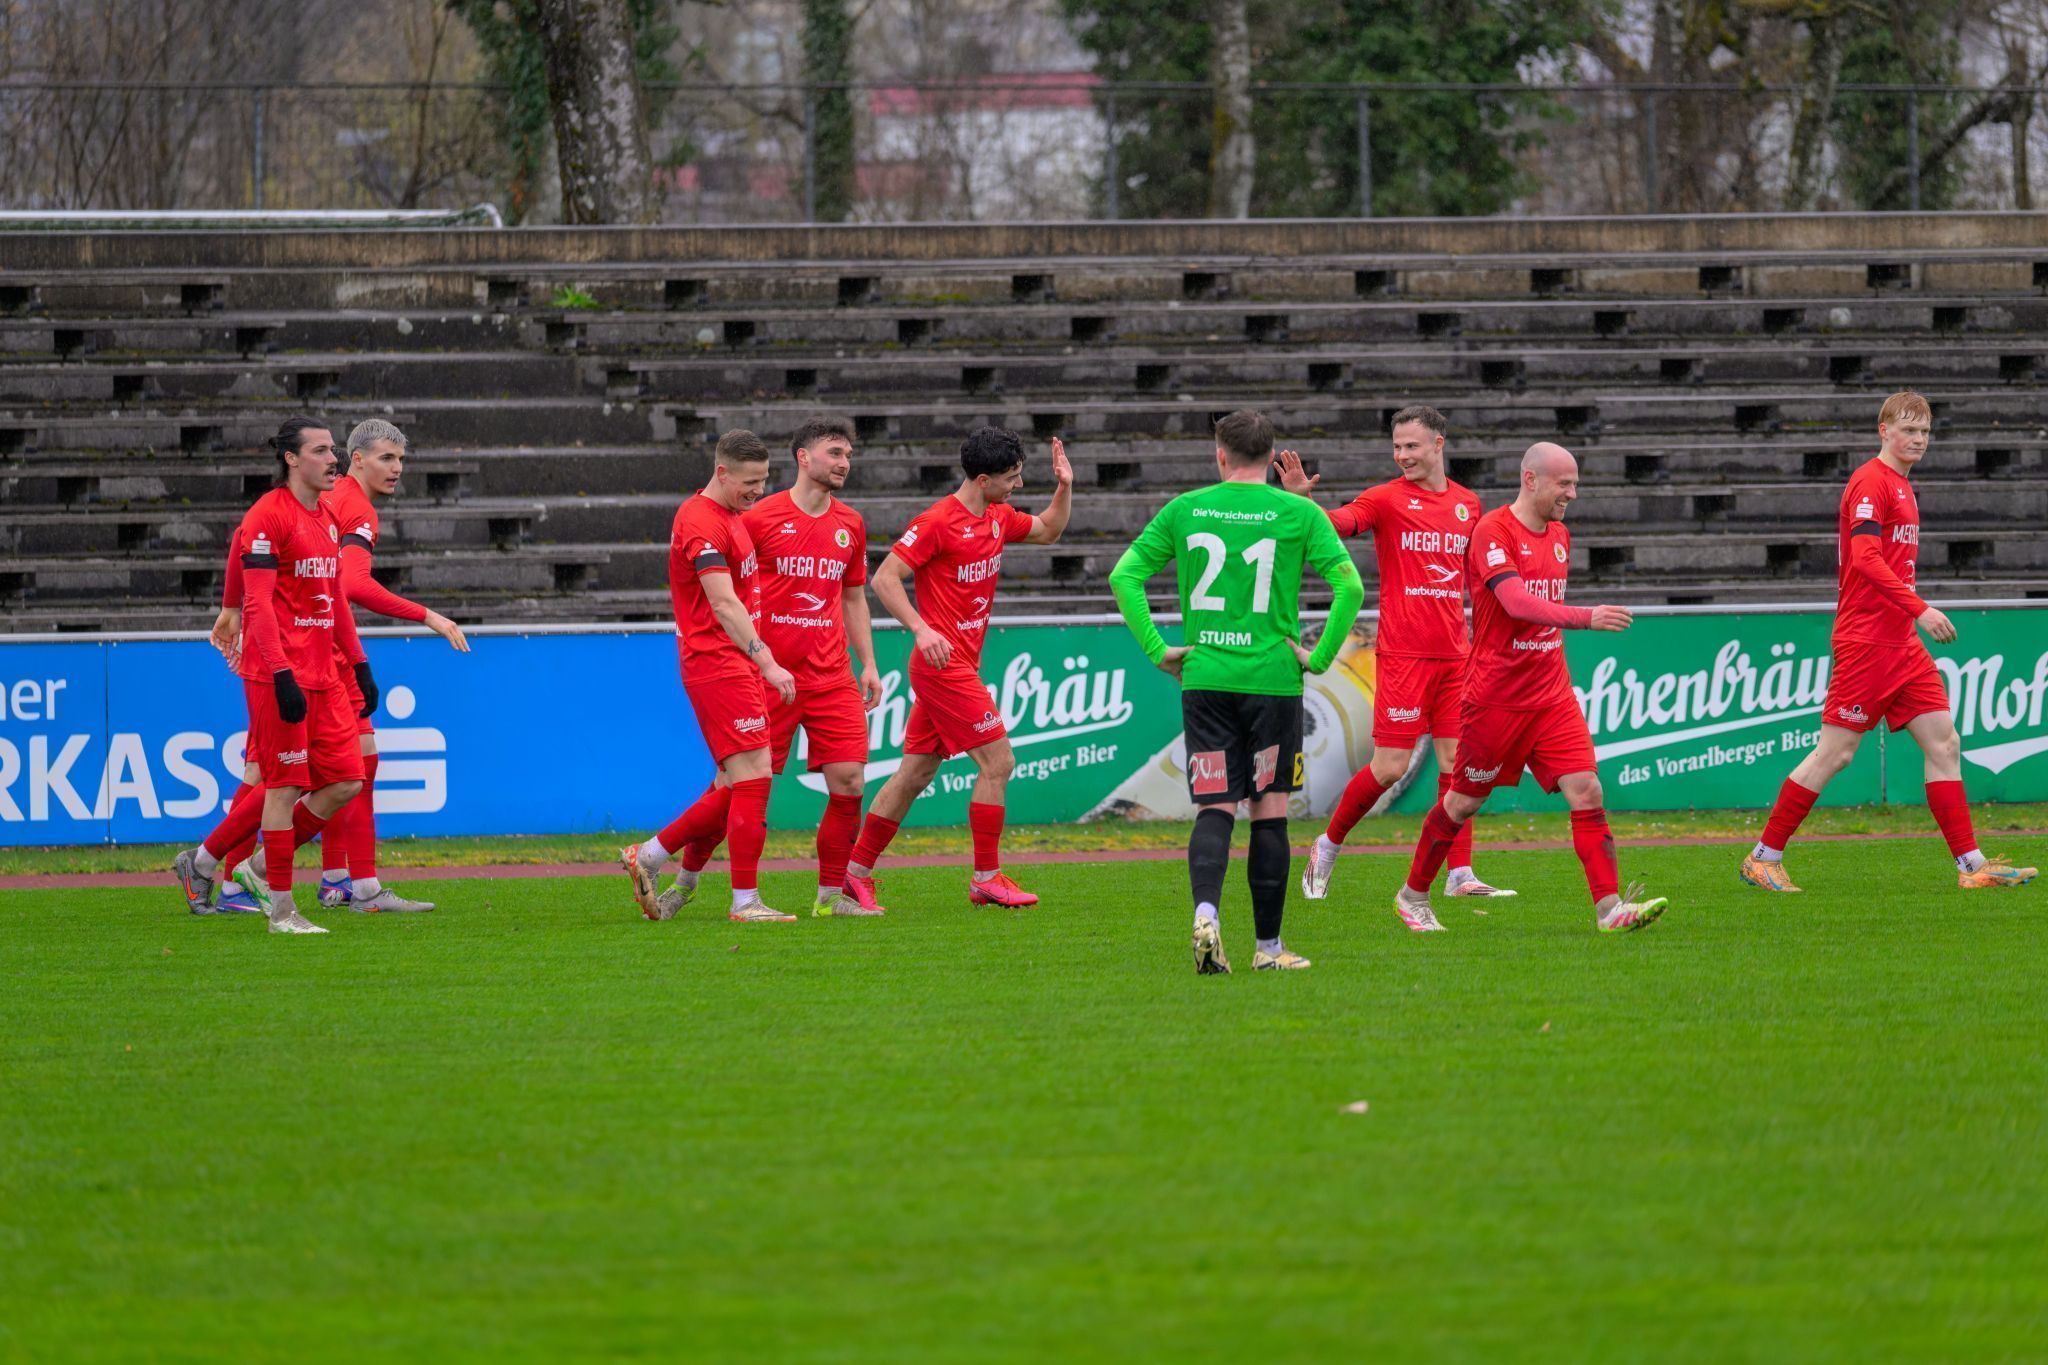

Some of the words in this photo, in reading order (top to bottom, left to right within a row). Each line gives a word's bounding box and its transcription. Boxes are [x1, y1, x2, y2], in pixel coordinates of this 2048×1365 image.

[1192, 508, 1264, 520] DieVersicherei
[1401, 531, 1440, 552] MEGA
[776, 556, 814, 578] MEGA
[957, 560, 986, 583] MEGA
[1186, 532, 1277, 614] 21
[1199, 630, 1252, 646] STURM
[0, 678, 67, 721] er
[1075, 743, 1118, 767] Bier
[1618, 764, 1651, 787] das
[1656, 739, 1776, 778] Vorarlberger
[1781, 730, 1821, 752] Bier
